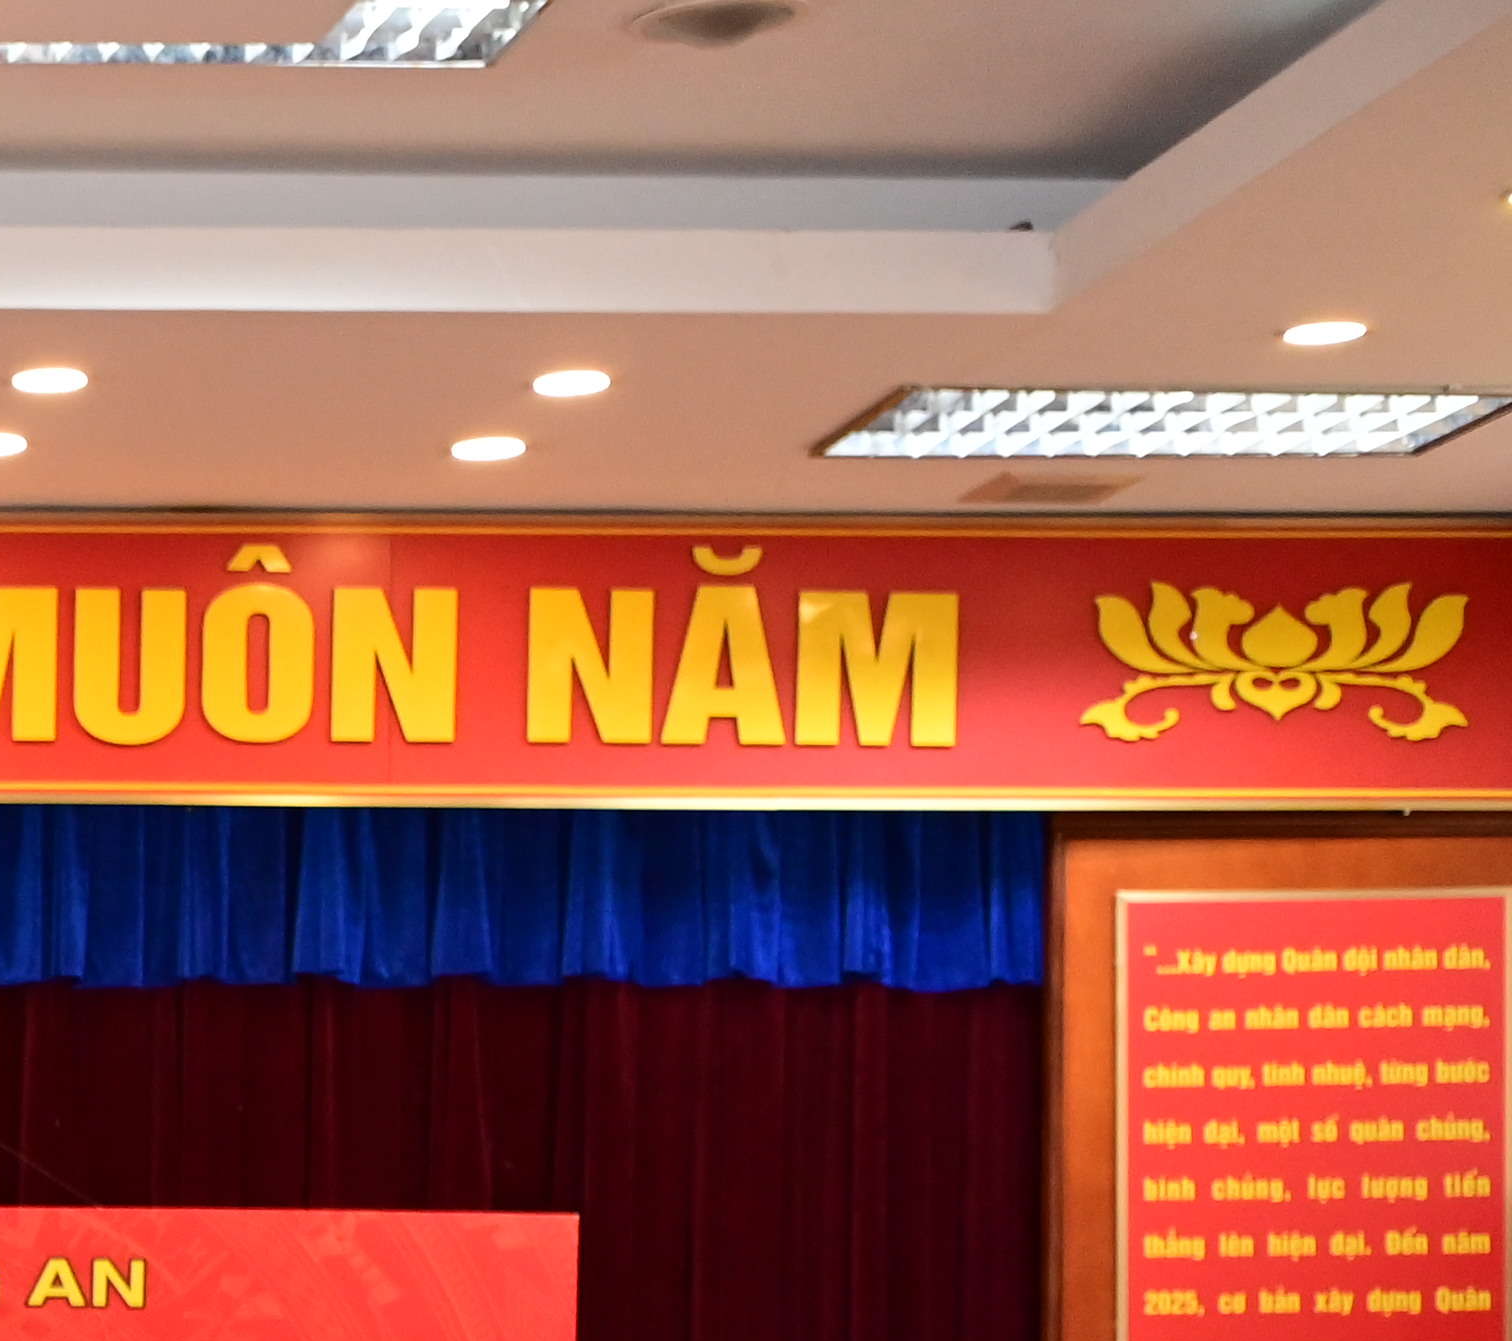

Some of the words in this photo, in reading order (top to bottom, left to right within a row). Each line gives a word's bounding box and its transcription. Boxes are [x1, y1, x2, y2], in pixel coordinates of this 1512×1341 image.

[526, 547, 958, 747] NĂM
[1208, 1009, 1237, 1031] an
[28, 1258, 145, 1308] AN
